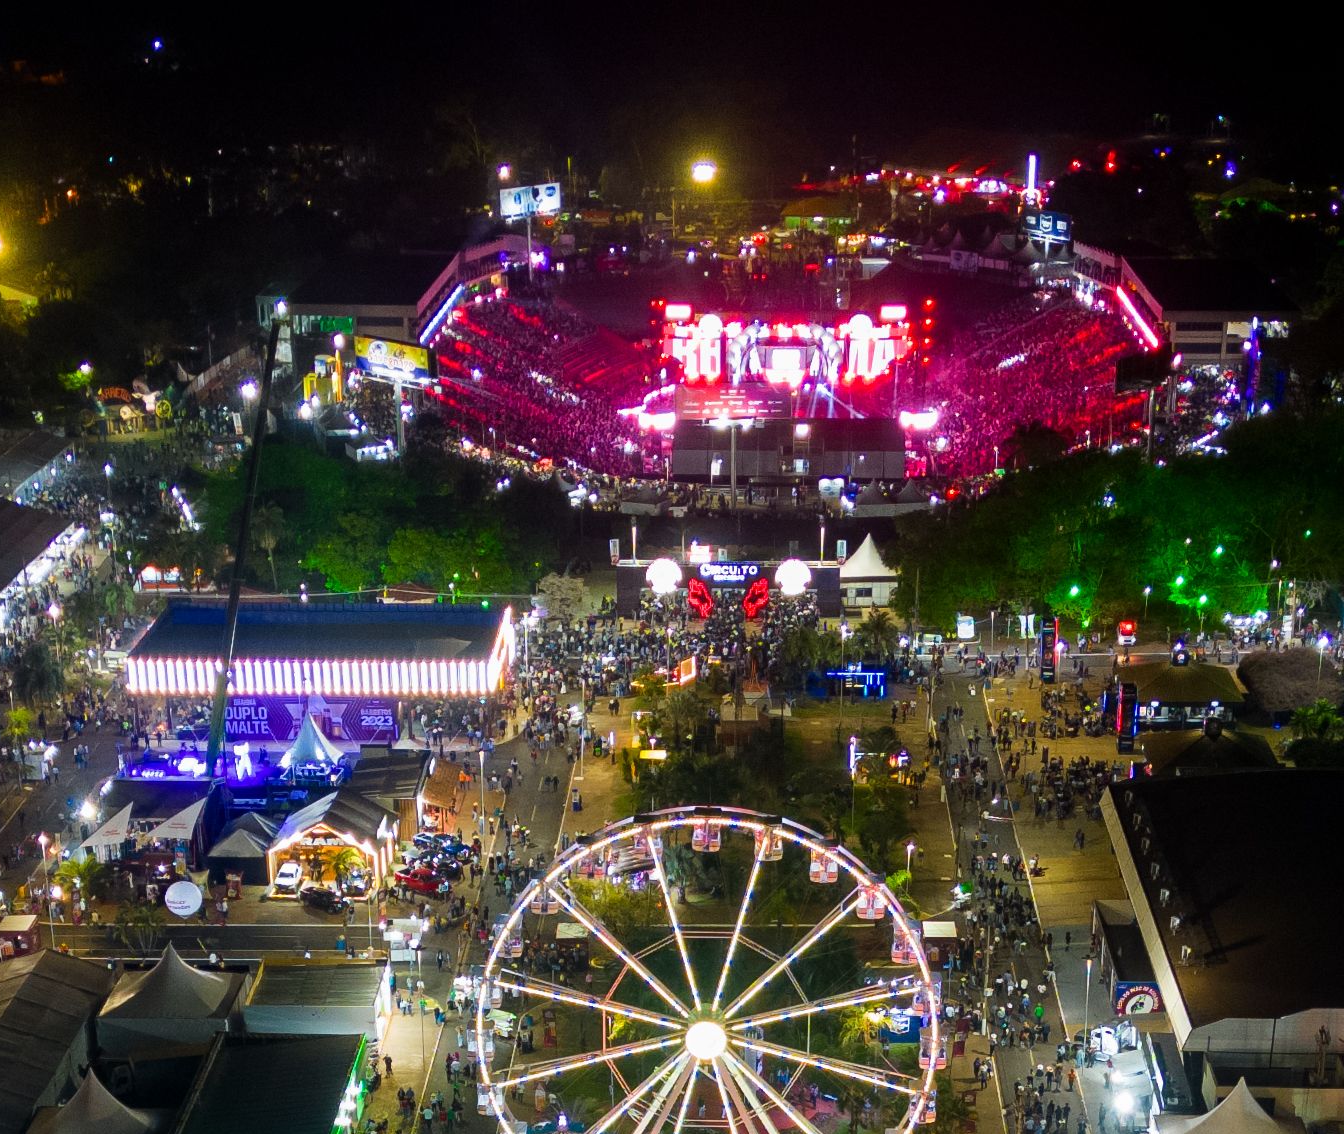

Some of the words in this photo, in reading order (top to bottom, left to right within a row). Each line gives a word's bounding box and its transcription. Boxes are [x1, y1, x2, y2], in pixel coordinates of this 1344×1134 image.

[225, 706, 268, 720] DUPLO
[225, 720, 269, 735] MALTE
[360, 715, 394, 726] 2023
